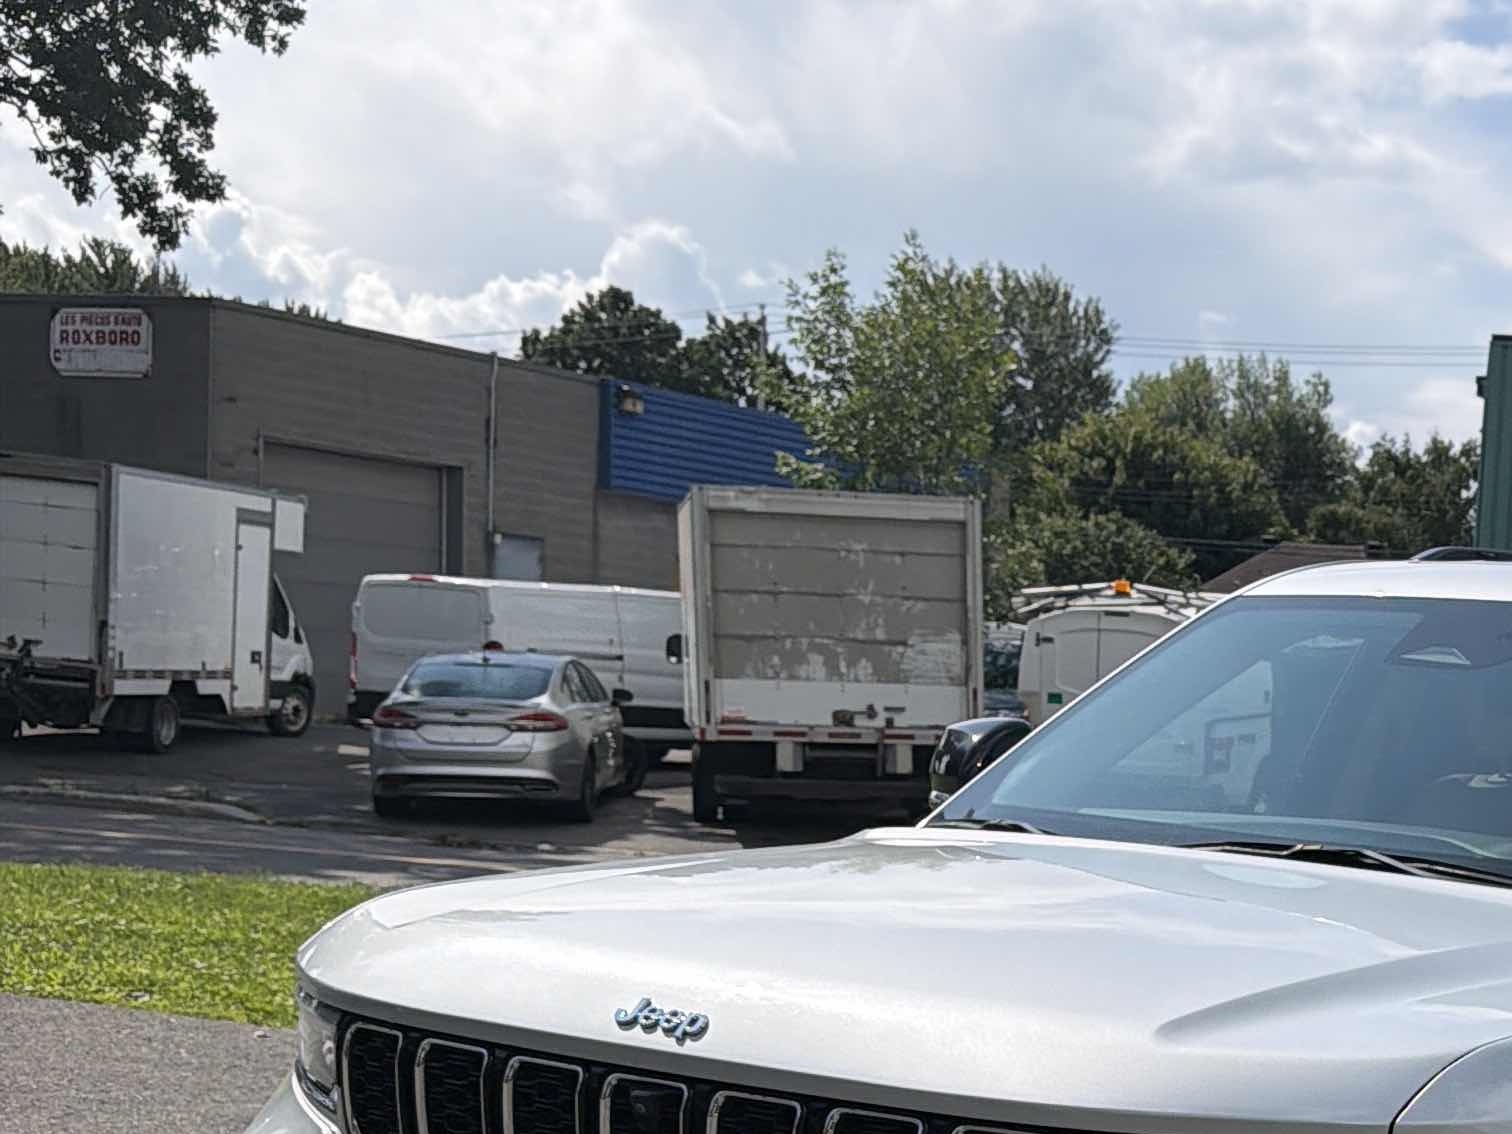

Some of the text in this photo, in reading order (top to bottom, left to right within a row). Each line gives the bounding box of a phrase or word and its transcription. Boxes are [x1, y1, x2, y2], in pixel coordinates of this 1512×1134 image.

[60, 313, 76, 326] LES
[60, 329, 141, 346] ROXBORO
[614, 997, 710, 1047] Jeep
